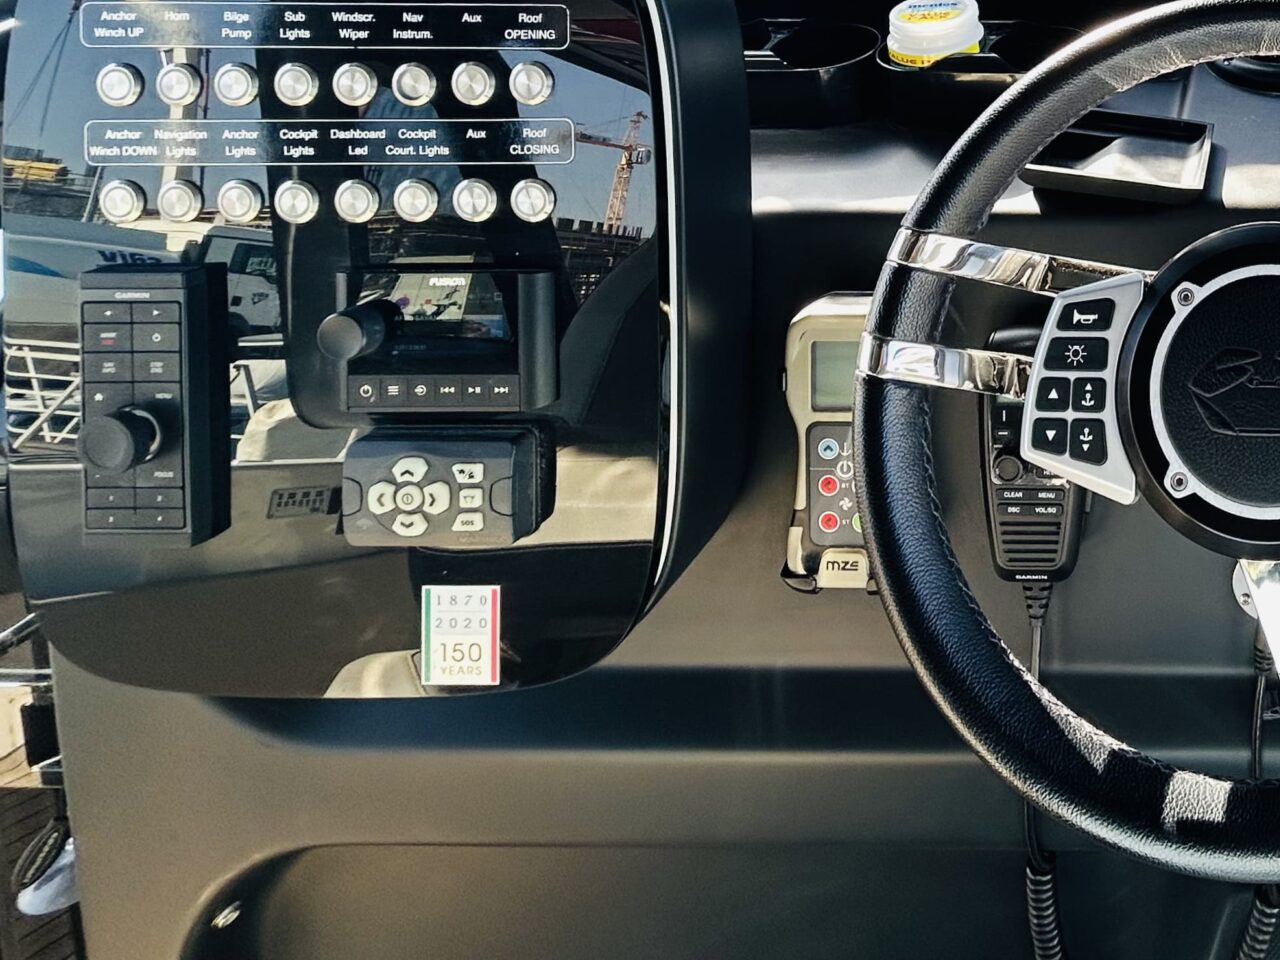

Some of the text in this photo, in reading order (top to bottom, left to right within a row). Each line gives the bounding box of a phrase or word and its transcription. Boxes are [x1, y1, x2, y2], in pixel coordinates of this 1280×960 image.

[100, 11, 137, 21] Anchor
[164, 11, 190, 21] Horn
[223, 12, 250, 23] Bilge
[284, 12, 306, 22] Sub
[331, 12, 376, 22] Windscr.
[402, 13, 424, 22] Nav
[461, 13, 482, 22] Aux
[518, 13, 542, 23] Roof
[94, 27, 144, 37] Winch UP
[221, 28, 251, 39] Pump
[279, 28, 311, 40] Lights
[338, 29, 370, 40] Wiper
[392, 29, 433, 39] Instrum.
[504, 30, 556, 39] OPENING
[105, 129, 143, 139] Anchor
[154, 130, 207, 141] Navigation
[222, 129, 259, 139] Anchor
[279, 129, 319, 141] Cockpit
[330, 129, 386, 139] Dashboard
[397, 129, 437, 141] Cockpit
[466, 129, 487, 139] Aux
[522, 128, 547, 138] Roof
[89, 146, 157, 156] Winch DOWN
[165, 146, 197, 158] Lights
[225, 146, 257, 158] Lights
[284, 145, 315, 157] Lights
[348, 145, 368, 155] Led
[385, 145, 449, 157] Court. Lights
[509, 145, 560, 155] CLOSING
[437, 594, 487, 606] 1870
[435, 617, 487, 629] 2020
[440, 642, 482, 662] 150
[440, 665, 482, 676] YEARS
